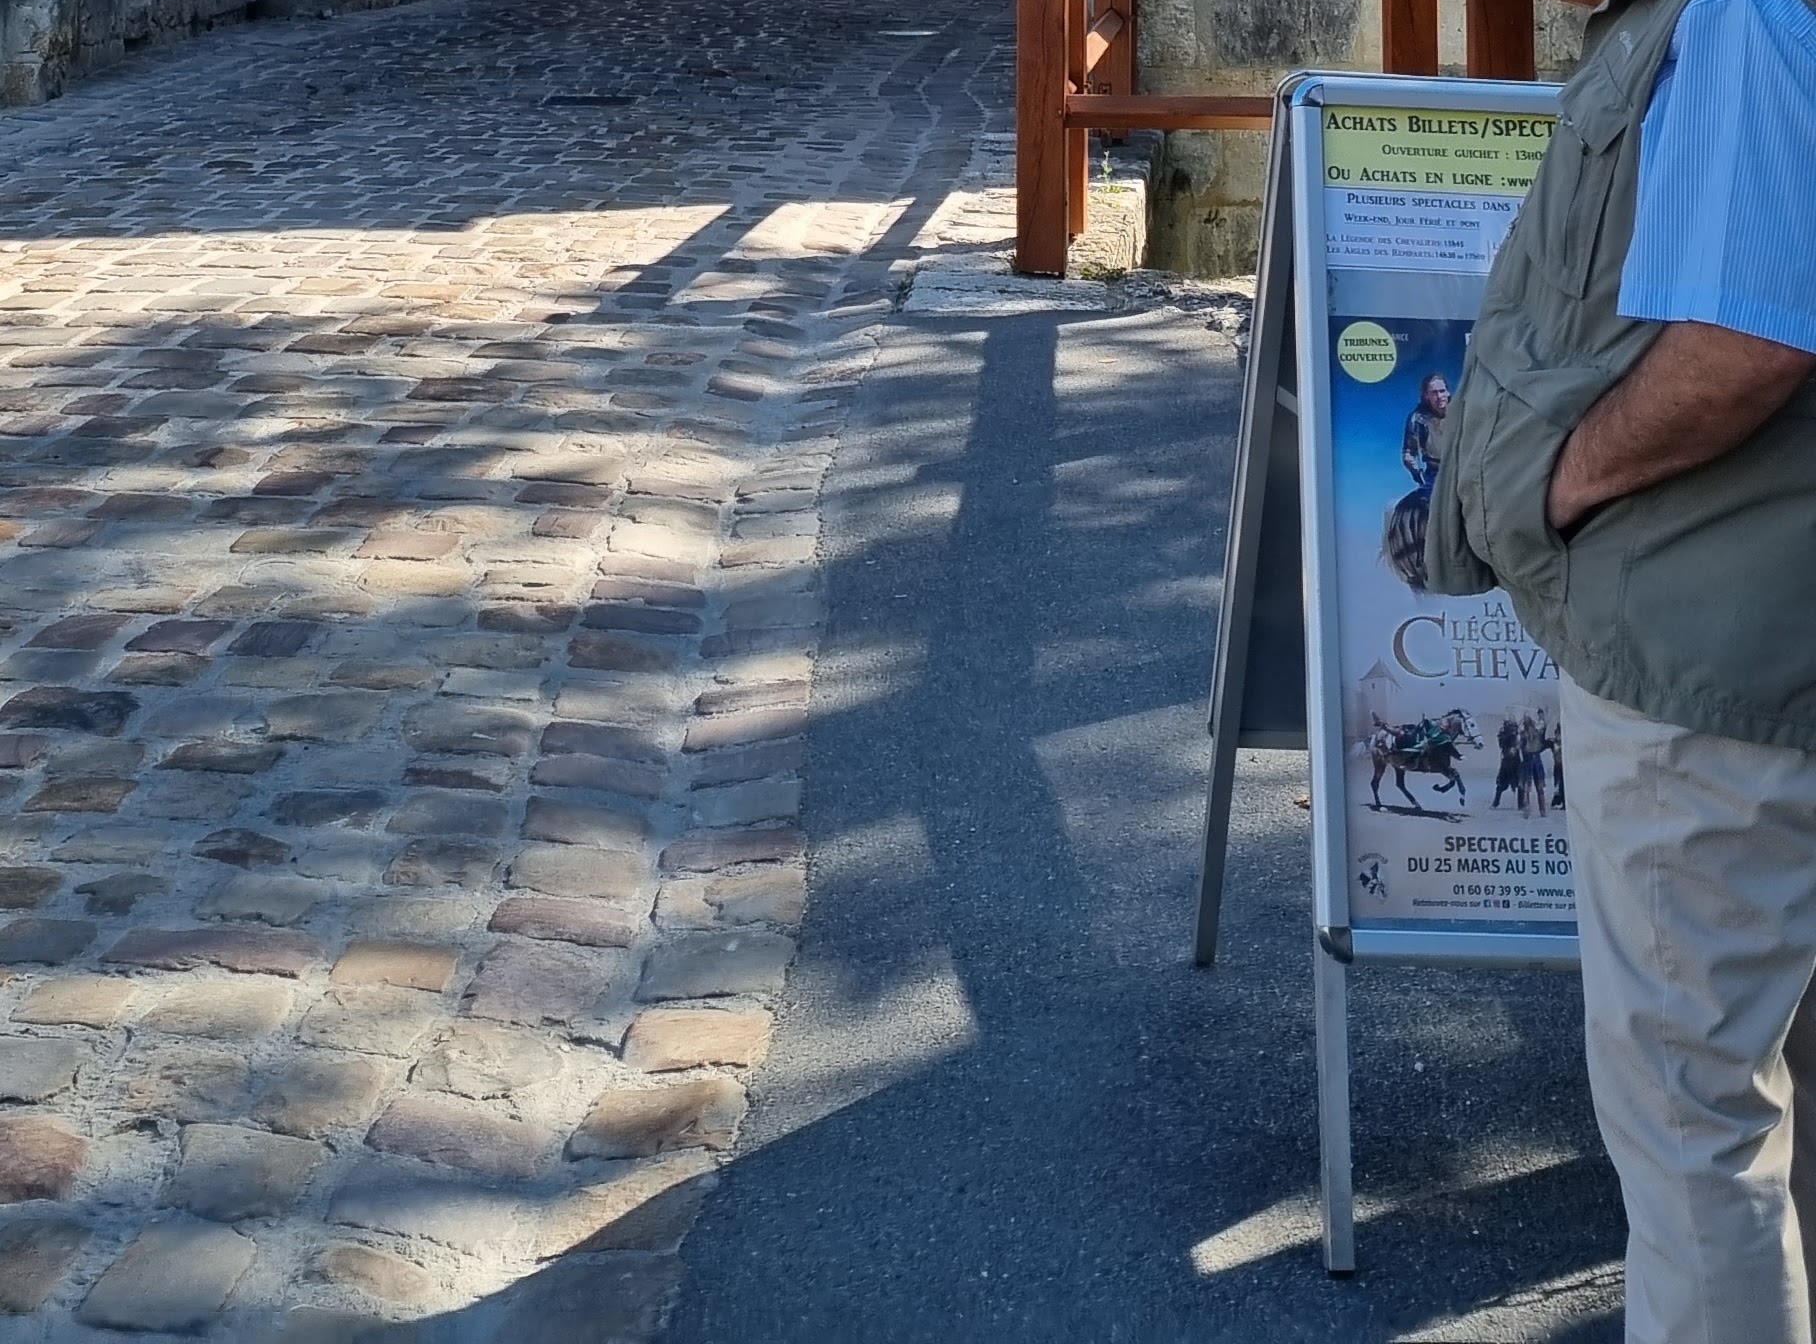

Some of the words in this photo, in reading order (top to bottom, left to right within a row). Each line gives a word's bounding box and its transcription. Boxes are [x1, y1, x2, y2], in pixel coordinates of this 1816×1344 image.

[1325, 111, 1397, 132] ACHATS
[1381, 144, 1449, 157] OUVERTURE
[1454, 148, 1500, 160] GUICHET
[1327, 165, 1351, 180] OU
[1359, 167, 1417, 183] ACHATS
[1425, 172, 1444, 184] EN
[1452, 173, 1493, 186] LIGNE
[1346, 192, 1406, 207] PLUSIEURS
[1411, 197, 1476, 210] SPECTACLES
[1482, 201, 1511, 212] DANS
[1343, 338, 1390, 347] TRIBUNES
[1340, 353, 1395, 362] COUVERTES
[1483, 601, 1507, 618] LA
[1444, 835, 1540, 854] SPECTACLE
[1408, 857, 1429, 872] DU
[1434, 857, 1452, 873] 25
[1457, 858, 1500, 874] MARS
[1505, 859, 1525, 874] AU
[1531, 860, 1540, 874] 5
[1453, 884, 1465, 895] 01
[1467, 885, 1481, 895] 60
[1484, 885, 1496, 895] 67
[1498, 885, 1511, 896] 39
[1513, 886, 1527, 896] 95
